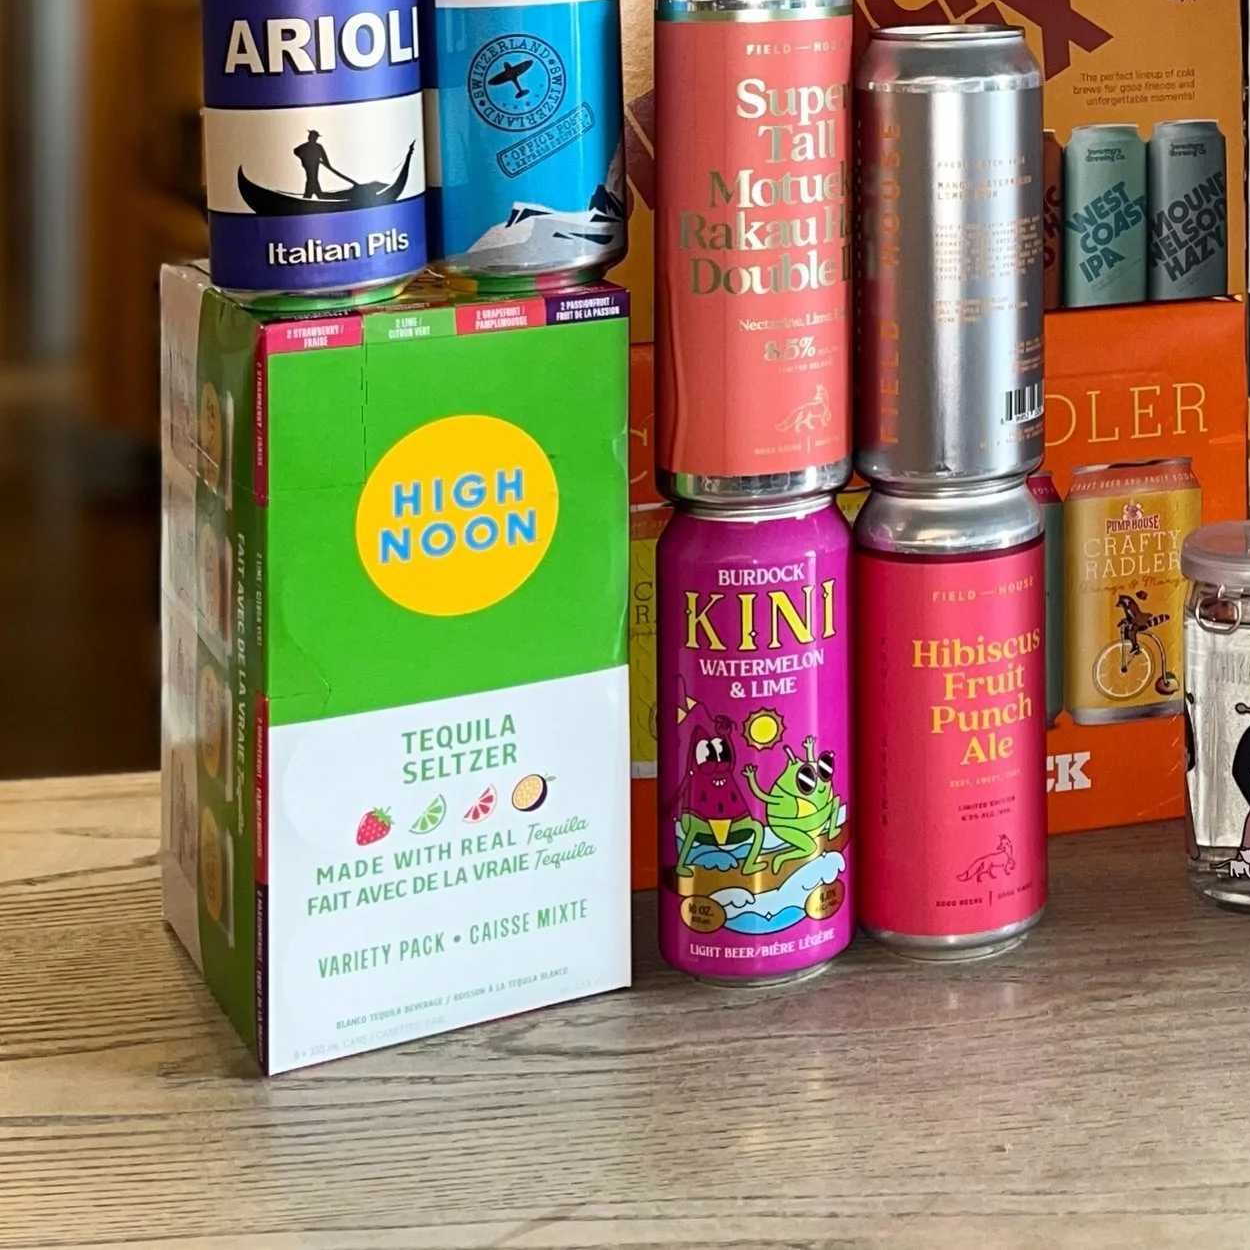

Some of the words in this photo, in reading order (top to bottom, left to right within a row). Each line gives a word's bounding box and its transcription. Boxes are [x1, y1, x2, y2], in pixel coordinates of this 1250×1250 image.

[1080, 72, 1097, 83] The
[1100, 69, 1132, 85] perfect
[1135, 69, 1162, 83] lineup
[1176, 68, 1195, 78] cold
[757, 117, 836, 163] Tall
[1068, 181, 1127, 235] WEST
[268, 238, 361, 266] Italian
[367, 227, 410, 257] Pils
[678, 211, 818, 252] Rakau
[689, 248, 837, 295] Double
[1079, 246, 1126, 283] IPA
[392, 468, 525, 519] HIGH
[379, 509, 538, 565] NOON
[1083, 530, 1182, 558] CRAFTY
[718, 563, 804, 587] BURDOCK
[1083, 553, 1182, 580] RADLER
[932, 589, 976, 602] FIELD
[998, 577, 1035, 595] HOUSE
[683, 578, 836, 652] KINI
[699, 648, 825, 678] WATERMELON
[912, 626, 1041, 668] Hibiscus
[729, 682, 747, 698] &
[751, 677, 797, 697] LIME
[943, 662, 1026, 701] Fruit
[931, 692, 1033, 734] Punch
[402, 714, 517, 755] TEQUILA
[960, 735, 1014, 766] Ale
[402, 743, 517, 785] SELTZER
[316, 856, 384, 886] MADE
[393, 841, 452, 871] WITH
[461, 830, 517, 857] REAL
[526, 816, 589, 846] Tequila
[307, 893, 349, 917] FAIT
[356, 880, 407, 907] AVEC
[413, 874, 439, 893] DE
[444, 869, 468, 889] LA
[473, 853, 529, 882] VRAIE
[534, 842, 596, 871] Tequila
[318, 944, 392, 979] VARIETY
[400, 933, 446, 961] PACK
[469, 913, 532, 946] CAISSE
[537, 899, 589, 930] MIXTE
[689, 942, 722, 959] LIGHT
